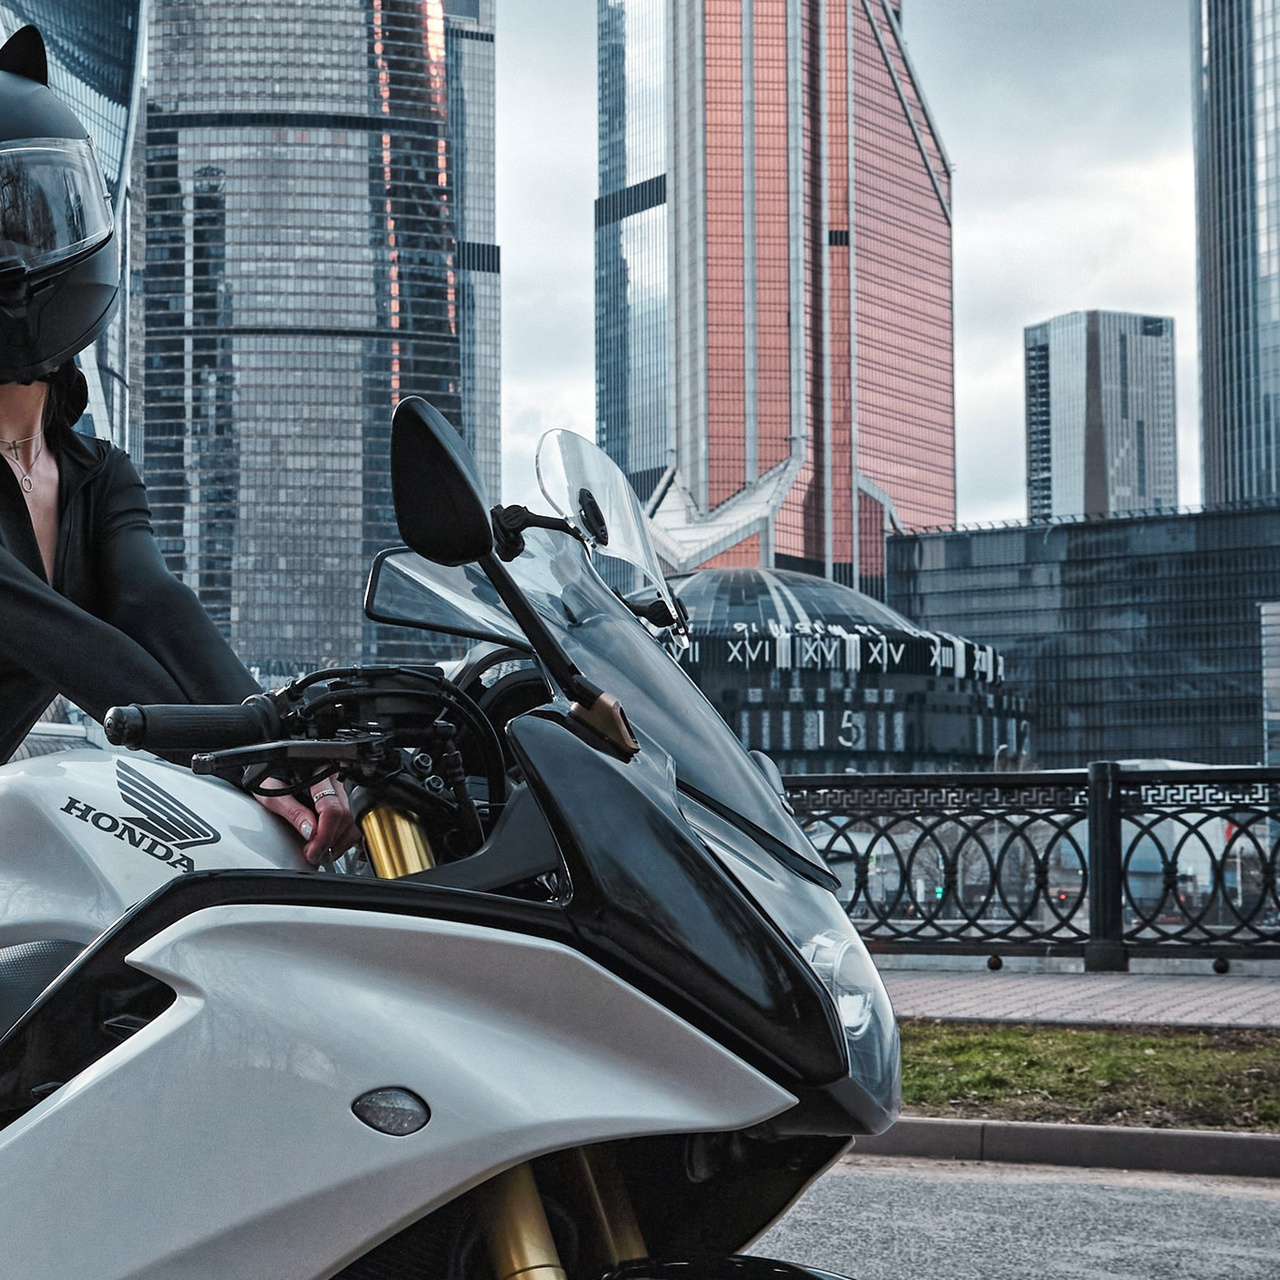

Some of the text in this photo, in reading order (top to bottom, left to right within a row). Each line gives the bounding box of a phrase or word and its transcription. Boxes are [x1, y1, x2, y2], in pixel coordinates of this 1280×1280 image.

[727, 640, 770, 663] XVI
[817, 710, 859, 748] 15
[60, 796, 196, 873] HONDA
